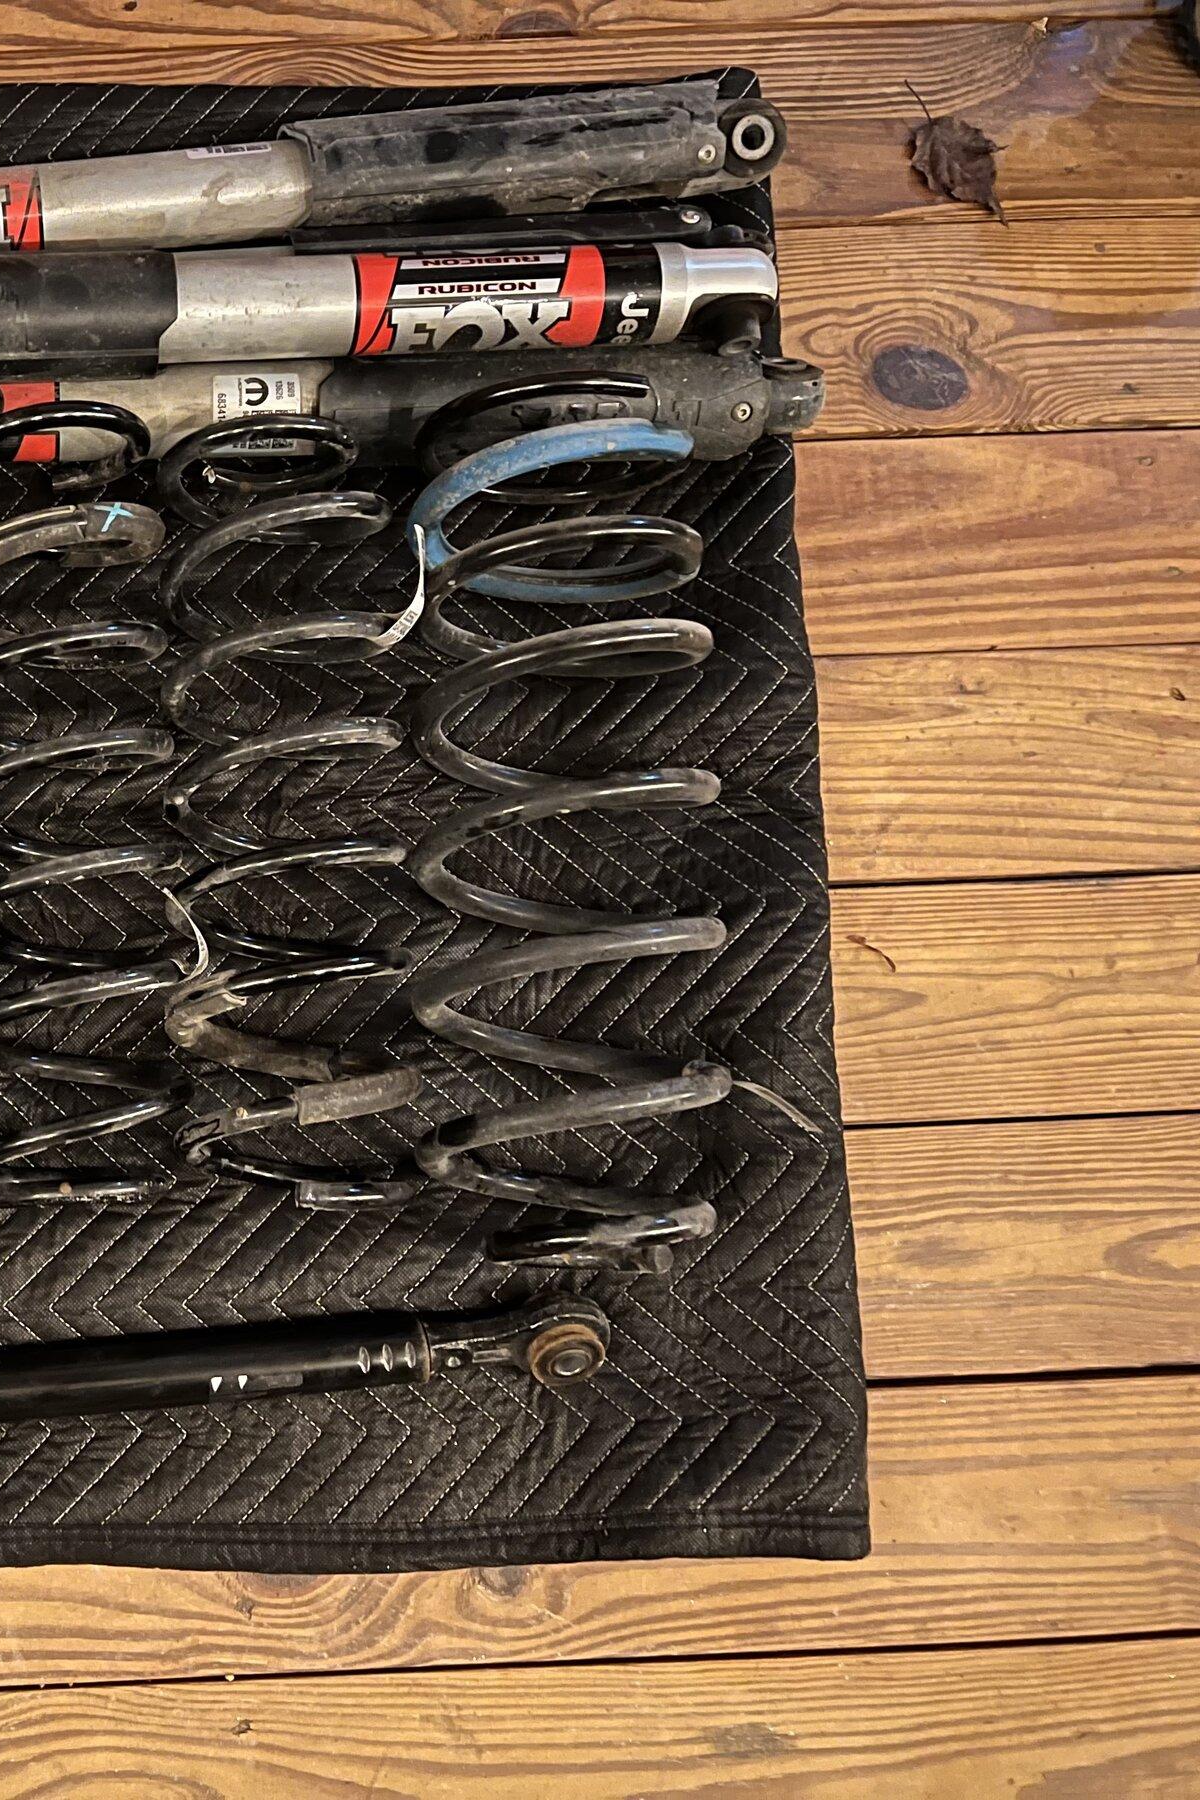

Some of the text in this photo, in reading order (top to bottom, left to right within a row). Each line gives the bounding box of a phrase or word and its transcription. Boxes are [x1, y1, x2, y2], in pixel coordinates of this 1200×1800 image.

[421, 255, 541, 267] RUBICON
[417, 281, 538, 295] RUBICON
[391, 298, 570, 353] FOX
[610, 291, 650, 343] Jee
[217, 392, 227, 421] 68341
